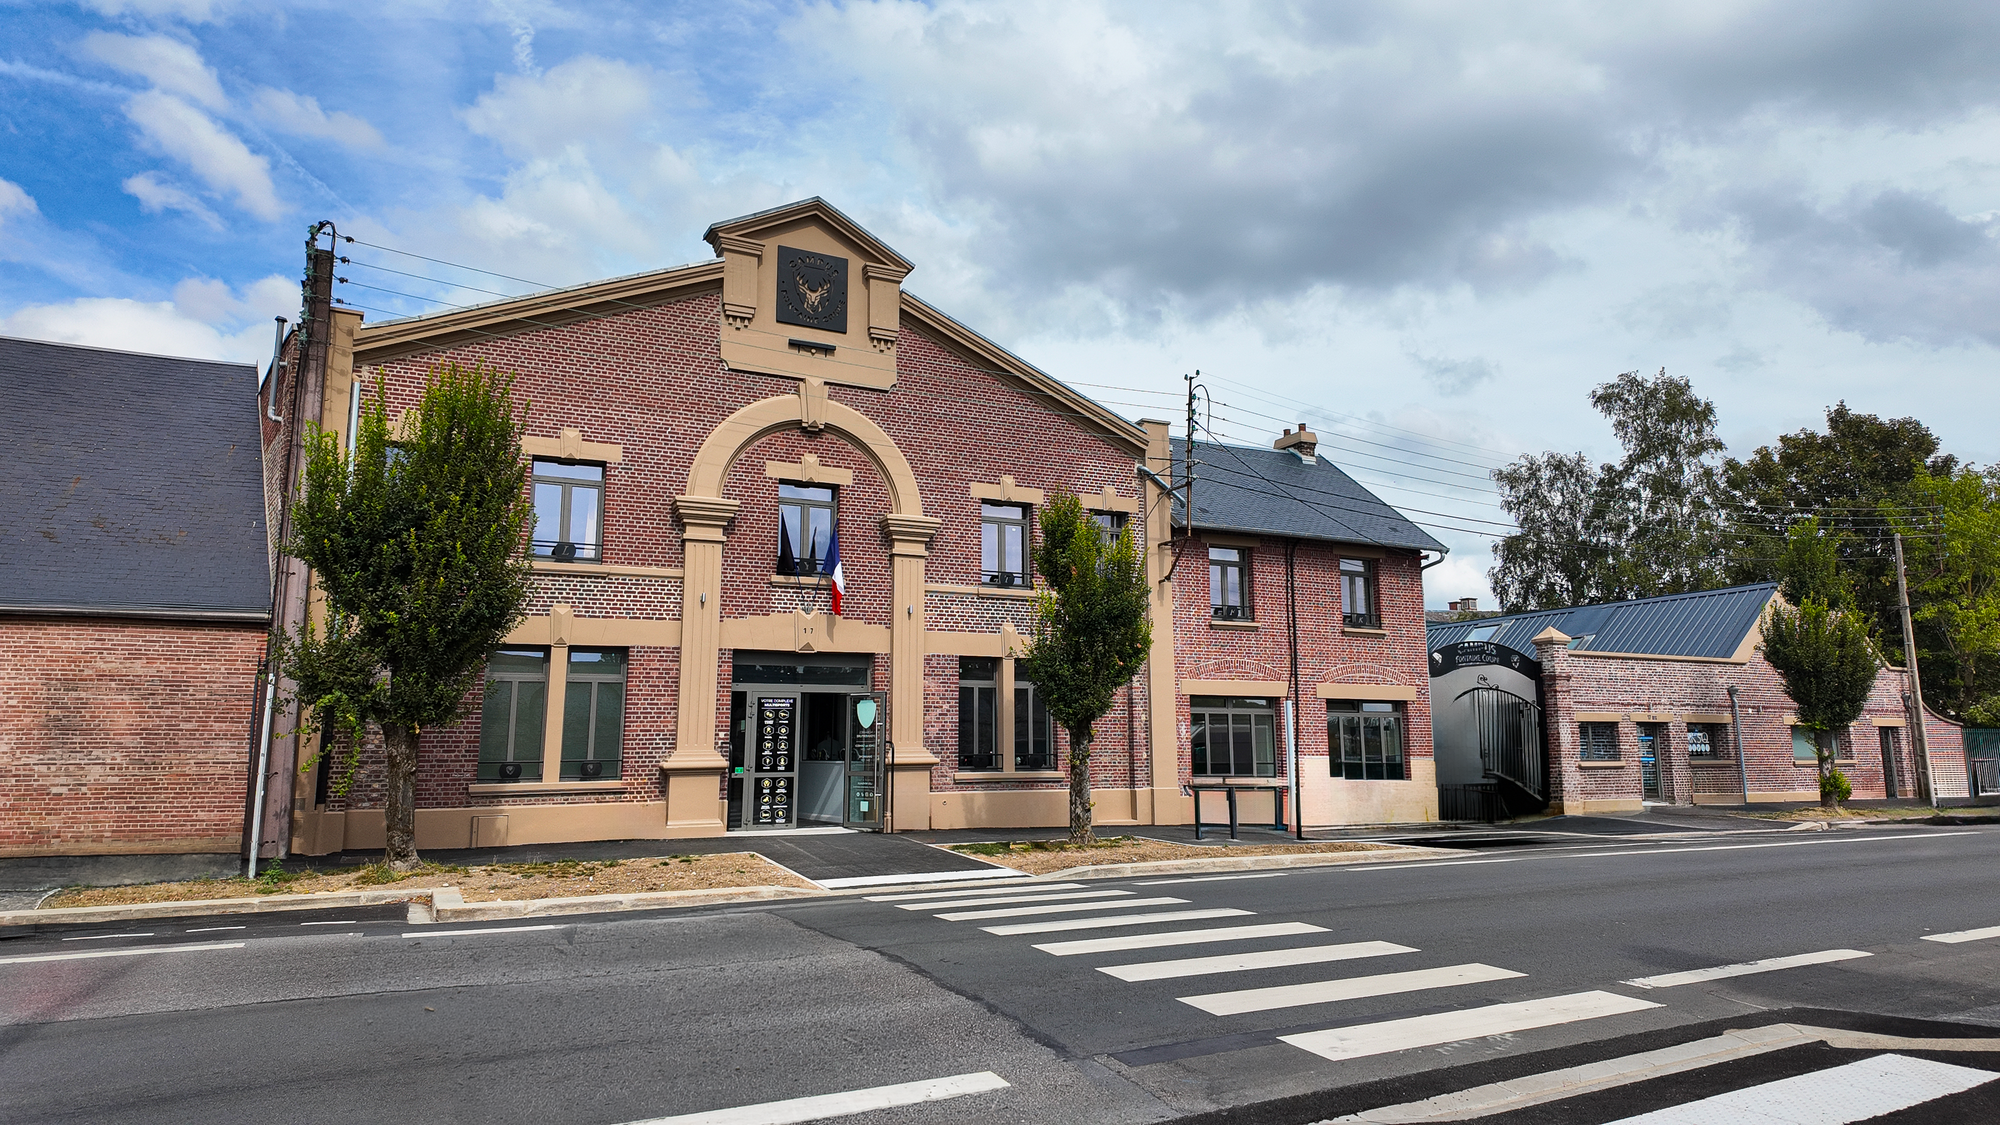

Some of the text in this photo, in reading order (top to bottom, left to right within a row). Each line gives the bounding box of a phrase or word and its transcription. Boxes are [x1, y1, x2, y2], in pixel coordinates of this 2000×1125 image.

[789, 255, 839, 279] CAMPUS
[780, 289, 820, 324] FONTAINE
[561, 545, 570, 556] L
[1457, 642, 1497, 655] CAMPUS
